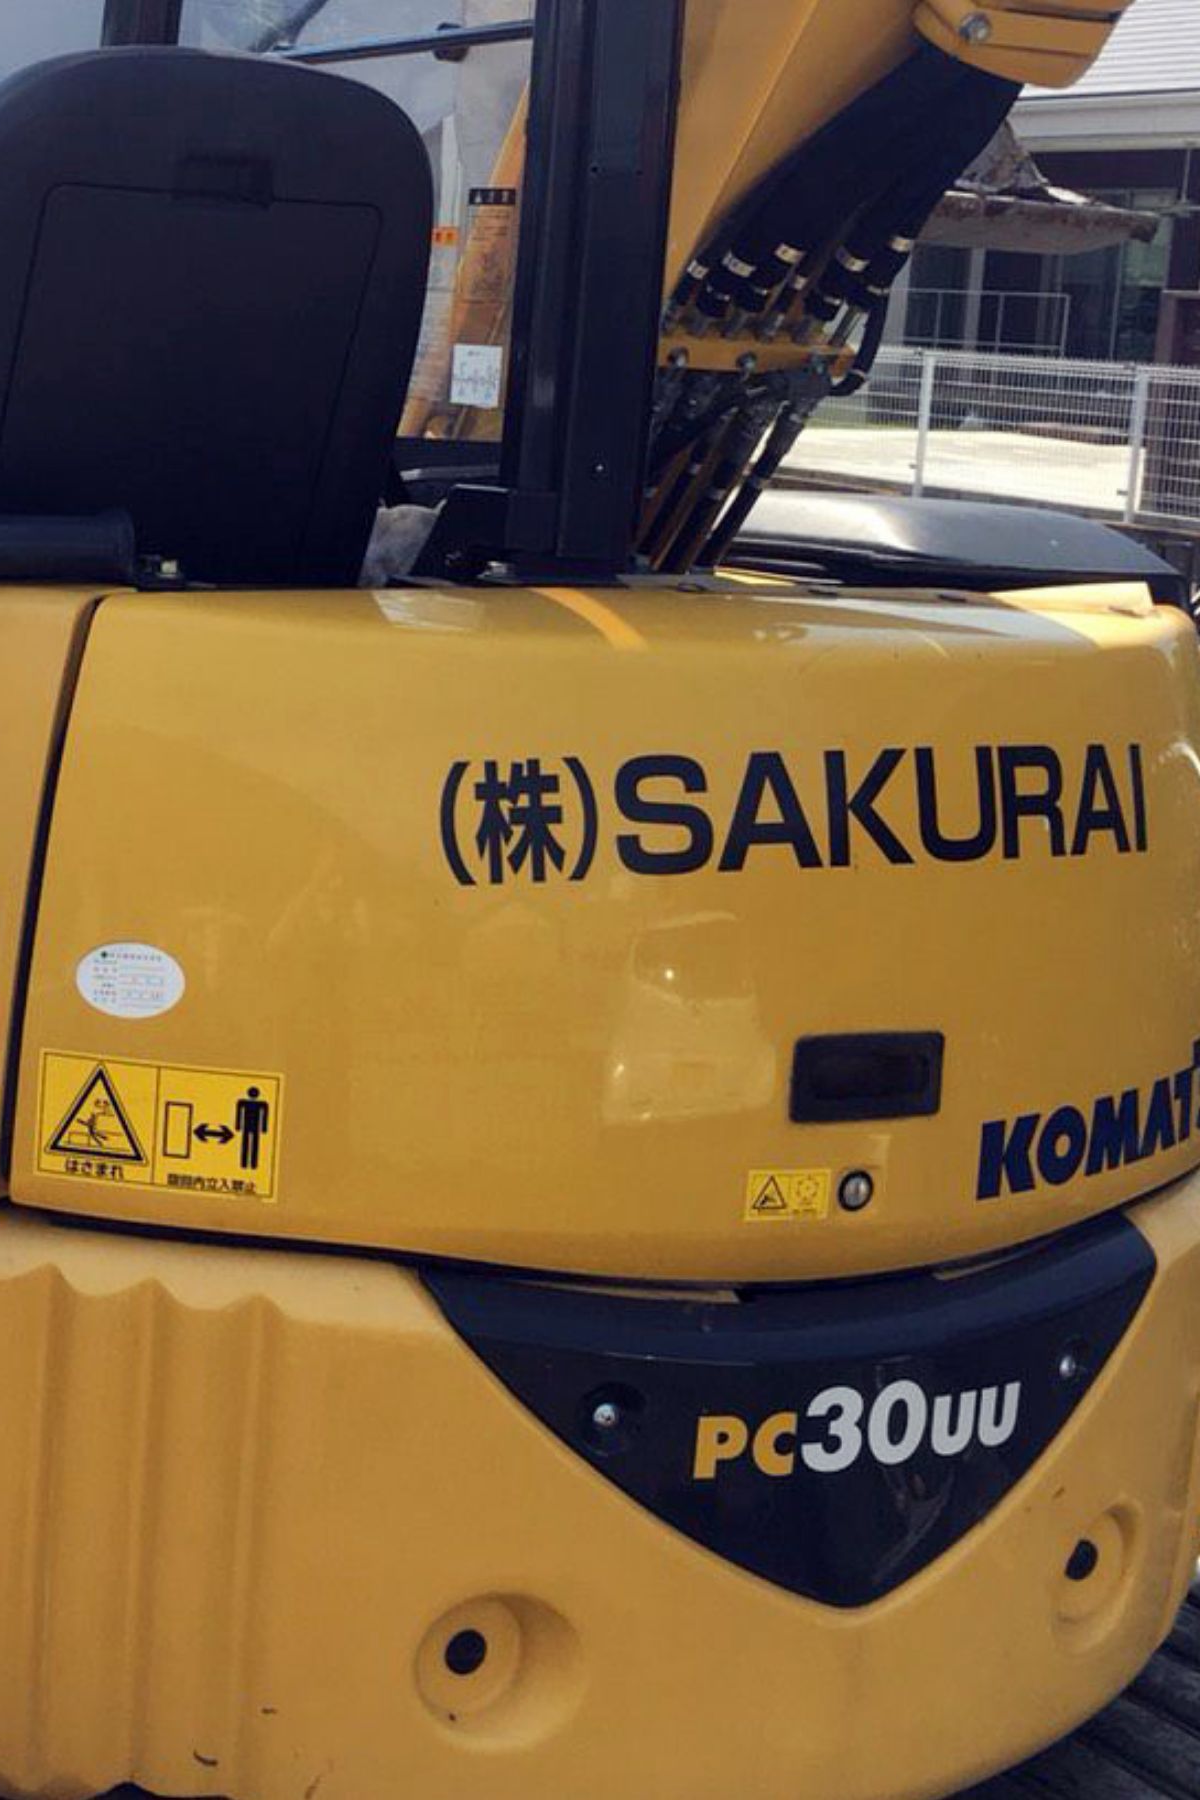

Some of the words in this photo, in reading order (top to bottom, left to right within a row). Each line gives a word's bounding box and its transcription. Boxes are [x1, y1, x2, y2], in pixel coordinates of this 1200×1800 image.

[65, 1158, 124, 1181] はさまれ
[976, 1037, 1200, 1201] KOMAT
[693, 1379, 1021, 1481] PC30UU
